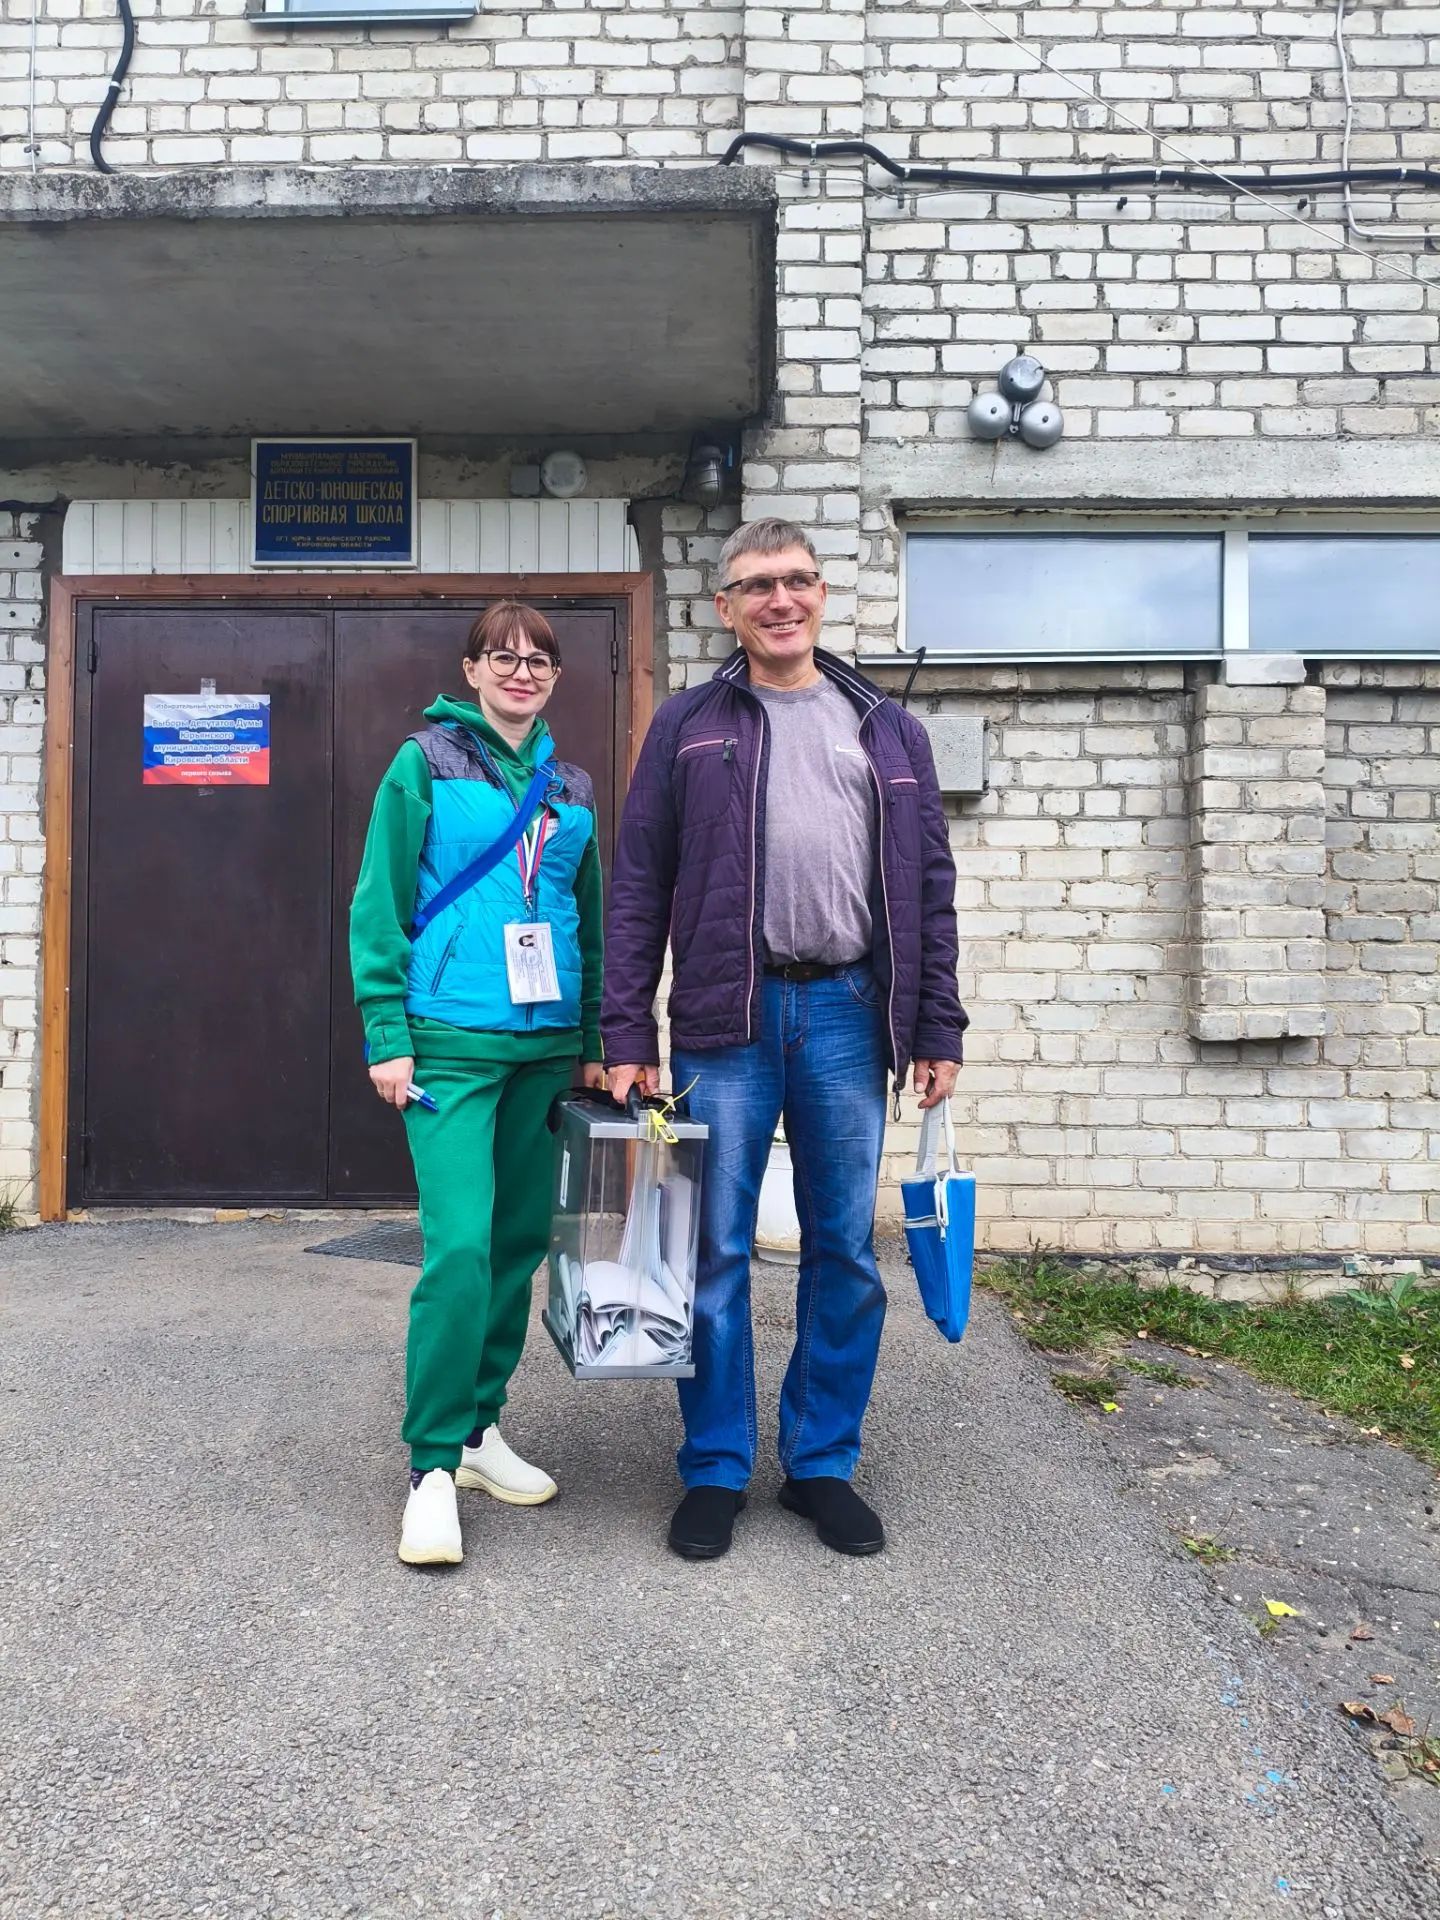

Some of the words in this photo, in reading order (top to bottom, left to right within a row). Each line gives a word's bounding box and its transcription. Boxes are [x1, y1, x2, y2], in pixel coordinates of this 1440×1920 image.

[264, 480, 404, 500] ДЕТСКО-ЮНОШЕСКАЯ
[263, 504, 347, 524] СПОРТИВНАЯ
[356, 504, 404, 524] ШКОЛА
[153, 719, 189, 729] Выборы
[236, 719, 262, 729] Думы
[180, 731, 234, 741] Юрьянского
[154, 744, 229, 754] муниципального
[230, 744, 260, 754] округа
[165, 755, 212, 765] Кировской
[213, 756, 249, 764] области
